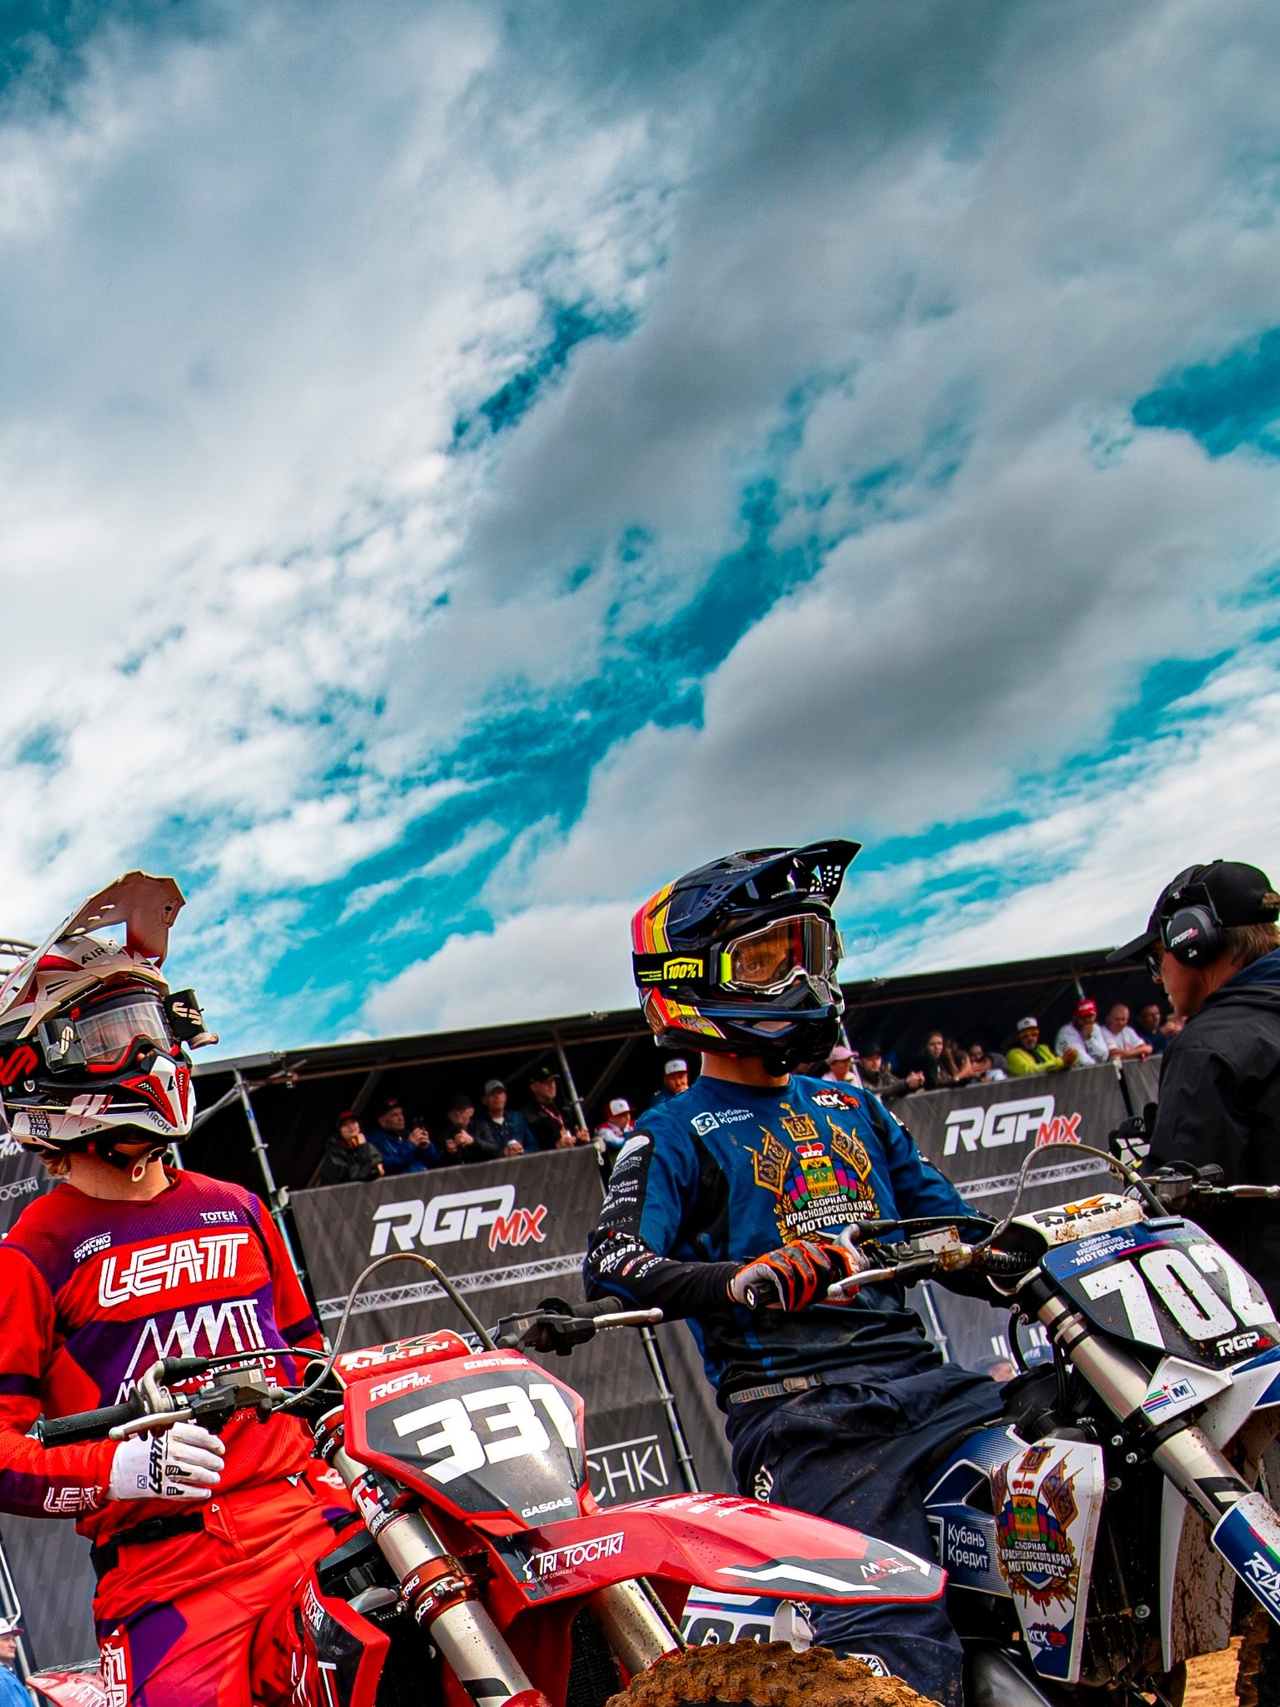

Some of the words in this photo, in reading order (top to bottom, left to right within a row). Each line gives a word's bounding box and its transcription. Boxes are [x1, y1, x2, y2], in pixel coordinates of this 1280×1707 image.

[668, 963, 697, 980] 100%
[719, 1112, 754, 1125] Кредит
[943, 1094, 1056, 1157] RGP
[1035, 1112, 1083, 1146] MX
[807, 1195, 848, 1209] СБОРНАЯ
[200, 1210, 238, 1223] TOTEK
[370, 1184, 516, 1256] RGP
[488, 1204, 548, 1253] MX
[97, 1232, 249, 1308] LEATT
[1078, 1244, 1280, 1350] 702
[1216, 1331, 1261, 1358] RGP
[369, 1371, 419, 1402] RGP
[392, 1383, 578, 1485] 331
[586, 1446, 669, 1503] CHKI
[521, 1497, 574, 1519] GASGAS
[947, 1523, 985, 1548] Кубань
[563, 1531, 625, 1569] TOCHKI
[947, 1545, 989, 1569] Кредит
[1007, 1561, 1067, 1579] МОТОКРОСС
